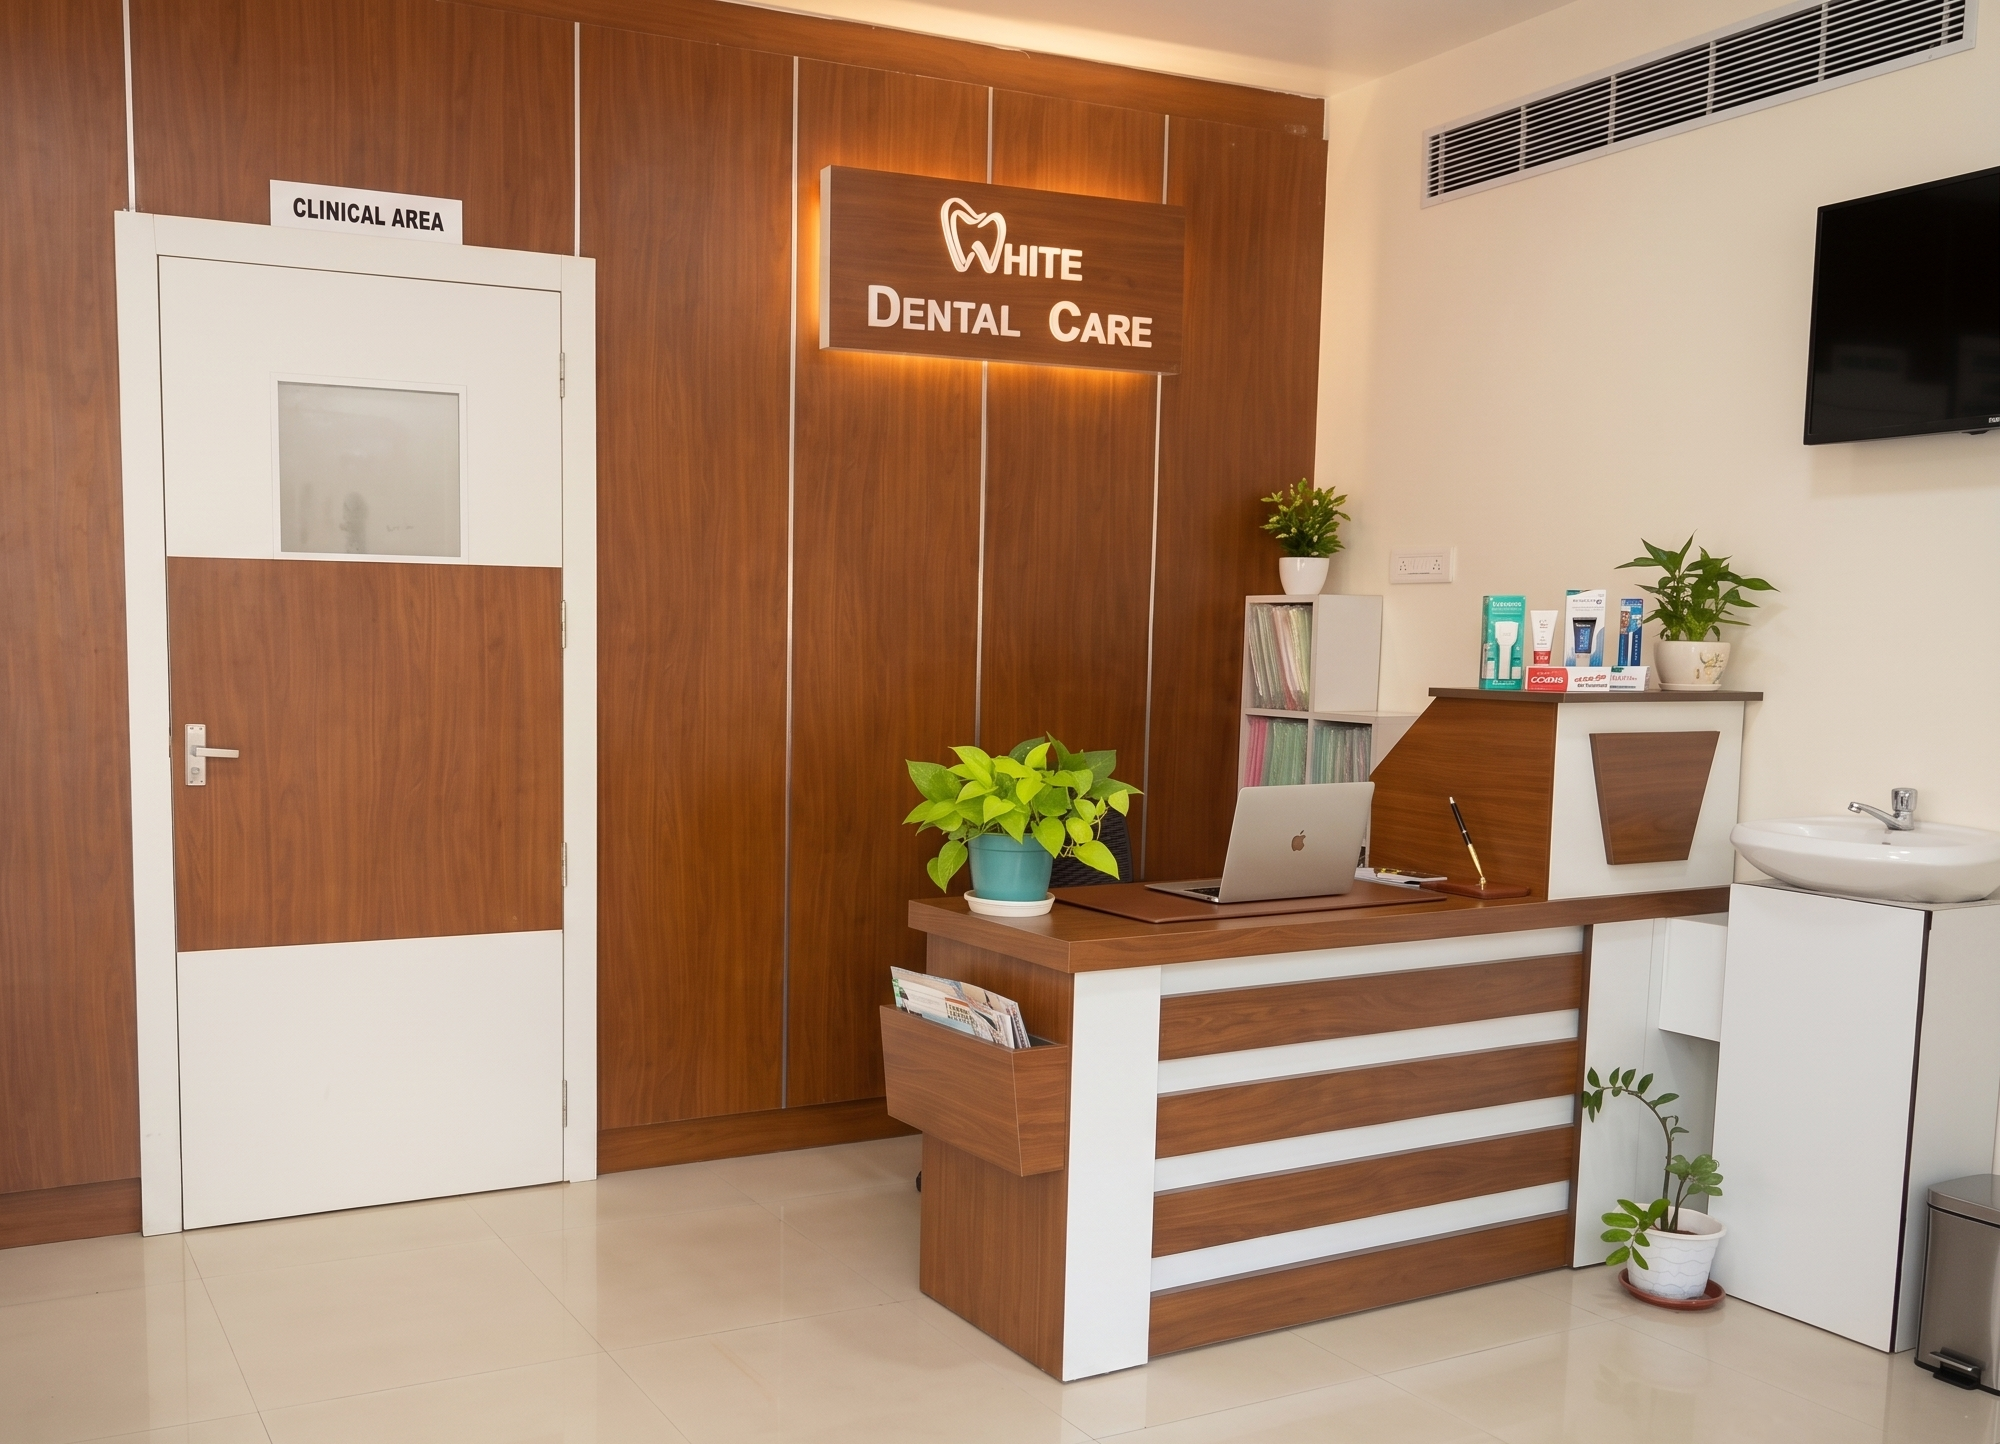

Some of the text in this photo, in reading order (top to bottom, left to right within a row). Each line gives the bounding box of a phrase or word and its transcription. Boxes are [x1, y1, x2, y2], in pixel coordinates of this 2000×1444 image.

[293, 197, 445, 232] CLINICAL AREA
[940, 197, 1082, 282] WHITE
[868, 284, 1153, 348] DENTAL CARE
